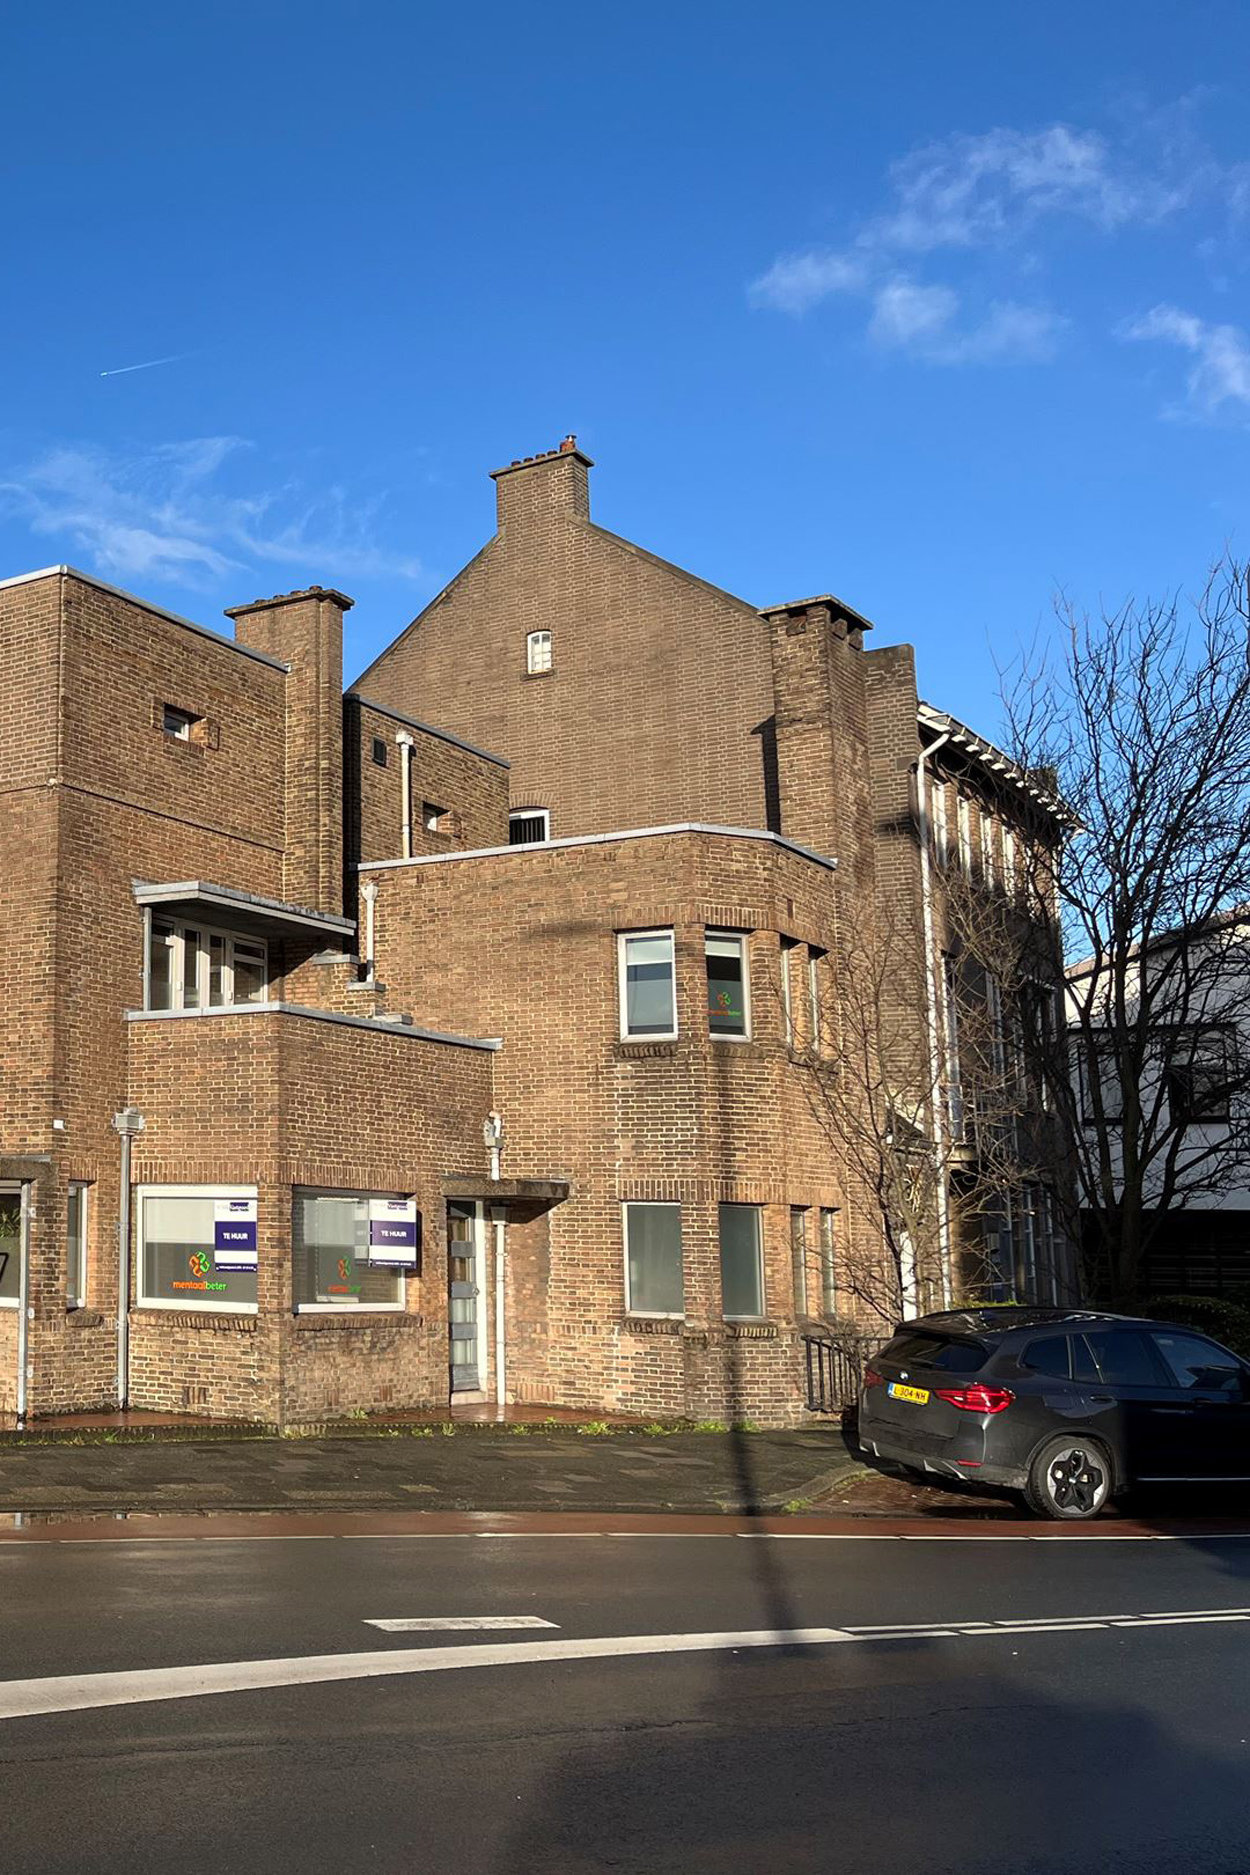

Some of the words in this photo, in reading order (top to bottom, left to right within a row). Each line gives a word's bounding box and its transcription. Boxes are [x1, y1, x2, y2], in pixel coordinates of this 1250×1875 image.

[222, 1232, 230, 1240] TE
[231, 1232, 249, 1240] HUUR
[380, 1229, 389, 1237] TE
[389, 1230, 407, 1238] HUUR
[172, 1281, 227, 1290] mentaalbeter
